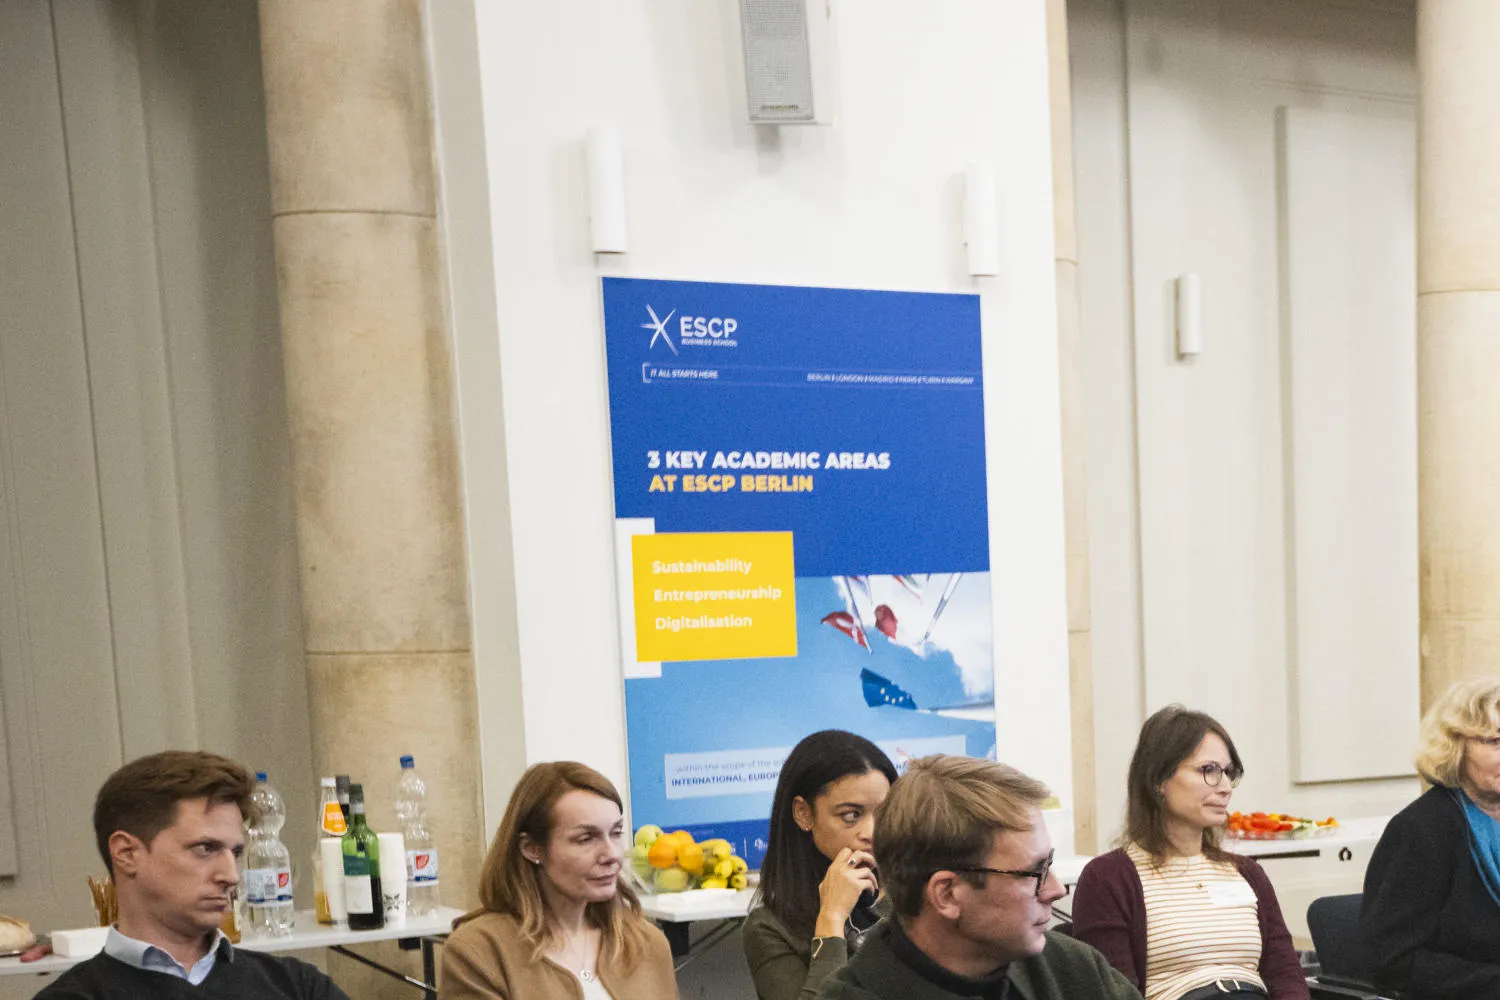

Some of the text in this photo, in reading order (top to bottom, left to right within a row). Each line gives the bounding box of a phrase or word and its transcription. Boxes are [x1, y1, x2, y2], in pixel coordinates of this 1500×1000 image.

[680, 316, 738, 338] ESCP
[647, 450, 891, 470] 3 KEY ACADEMIC AREAS
[649, 475, 814, 492] AT ESCP BERLIN
[652, 557, 752, 574] Sustainability
[653, 585, 782, 603] Entrepreneurship
[655, 614, 753, 632] Digitalisation
[671, 771, 779, 787] INTERNATIONAL, EUROP
